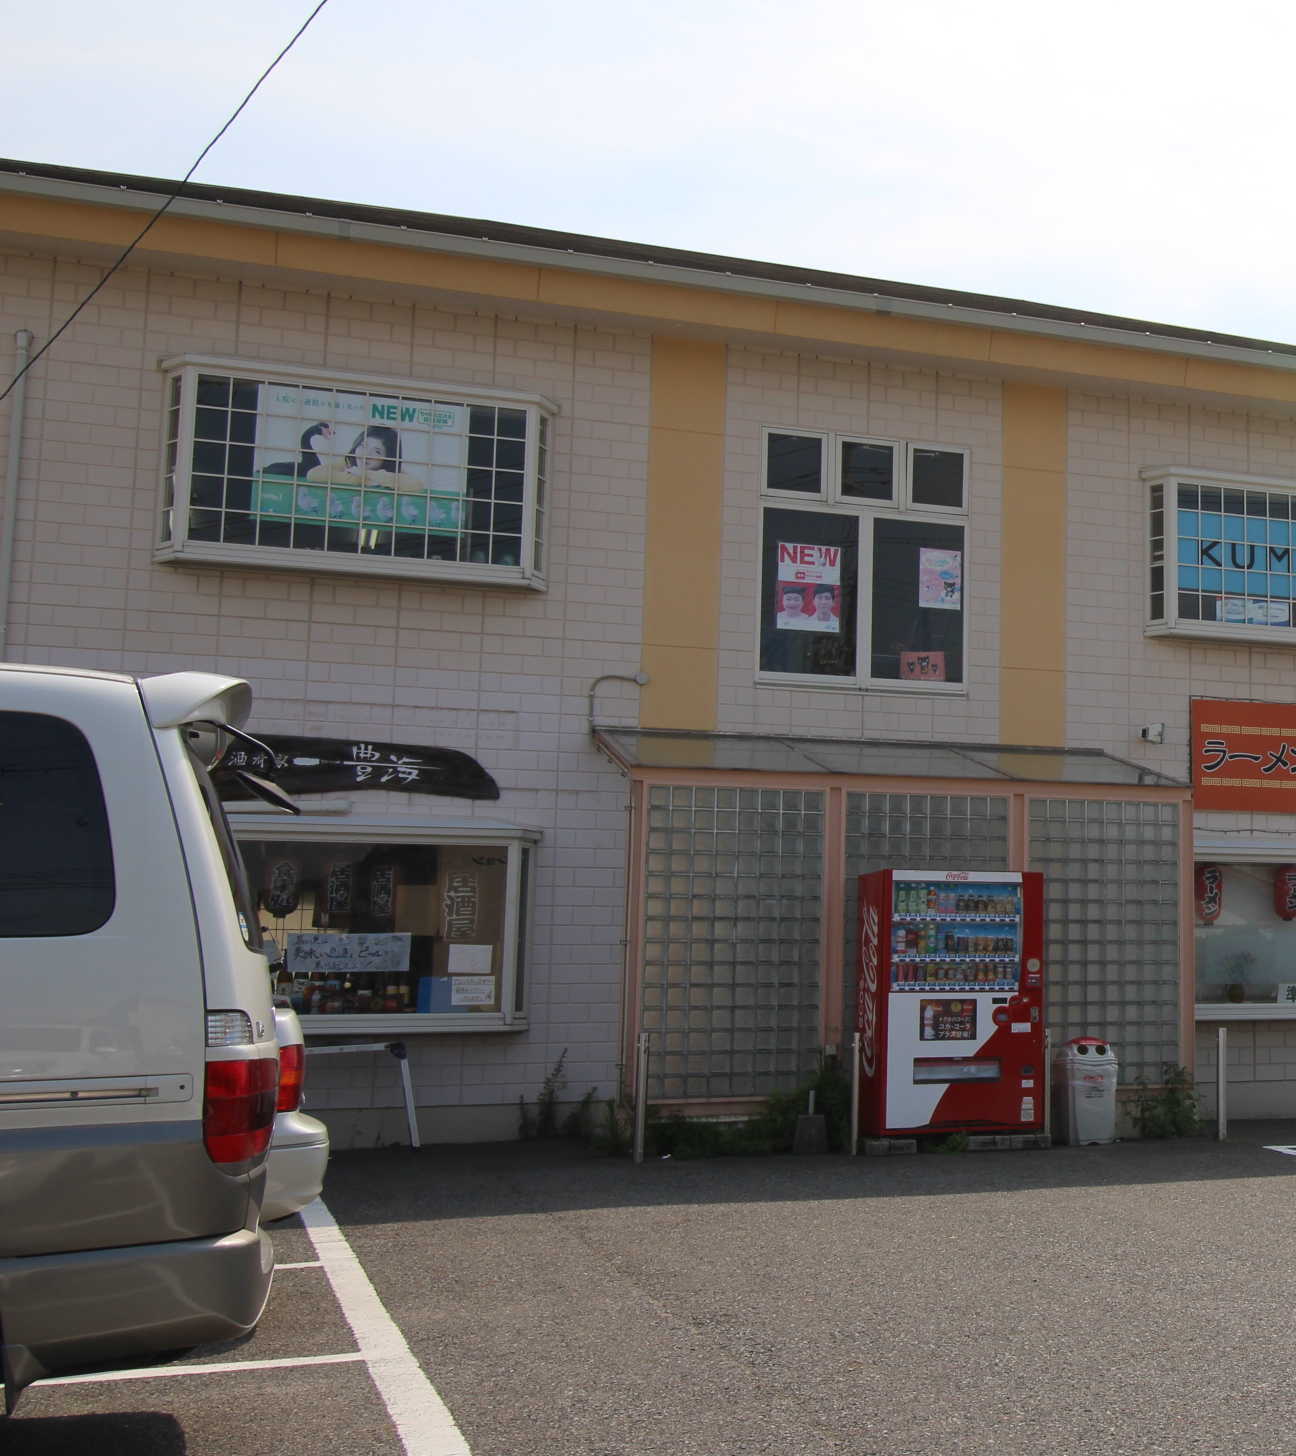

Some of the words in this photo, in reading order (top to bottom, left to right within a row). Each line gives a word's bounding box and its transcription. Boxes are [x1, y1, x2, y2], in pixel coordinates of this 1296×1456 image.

[371, 403, 417, 423] NEW
[779, 543, 840, 568] NEW
[443, 870, 478, 941] 居酒屋
[1202, 868, 1222, 918] ラーメン
